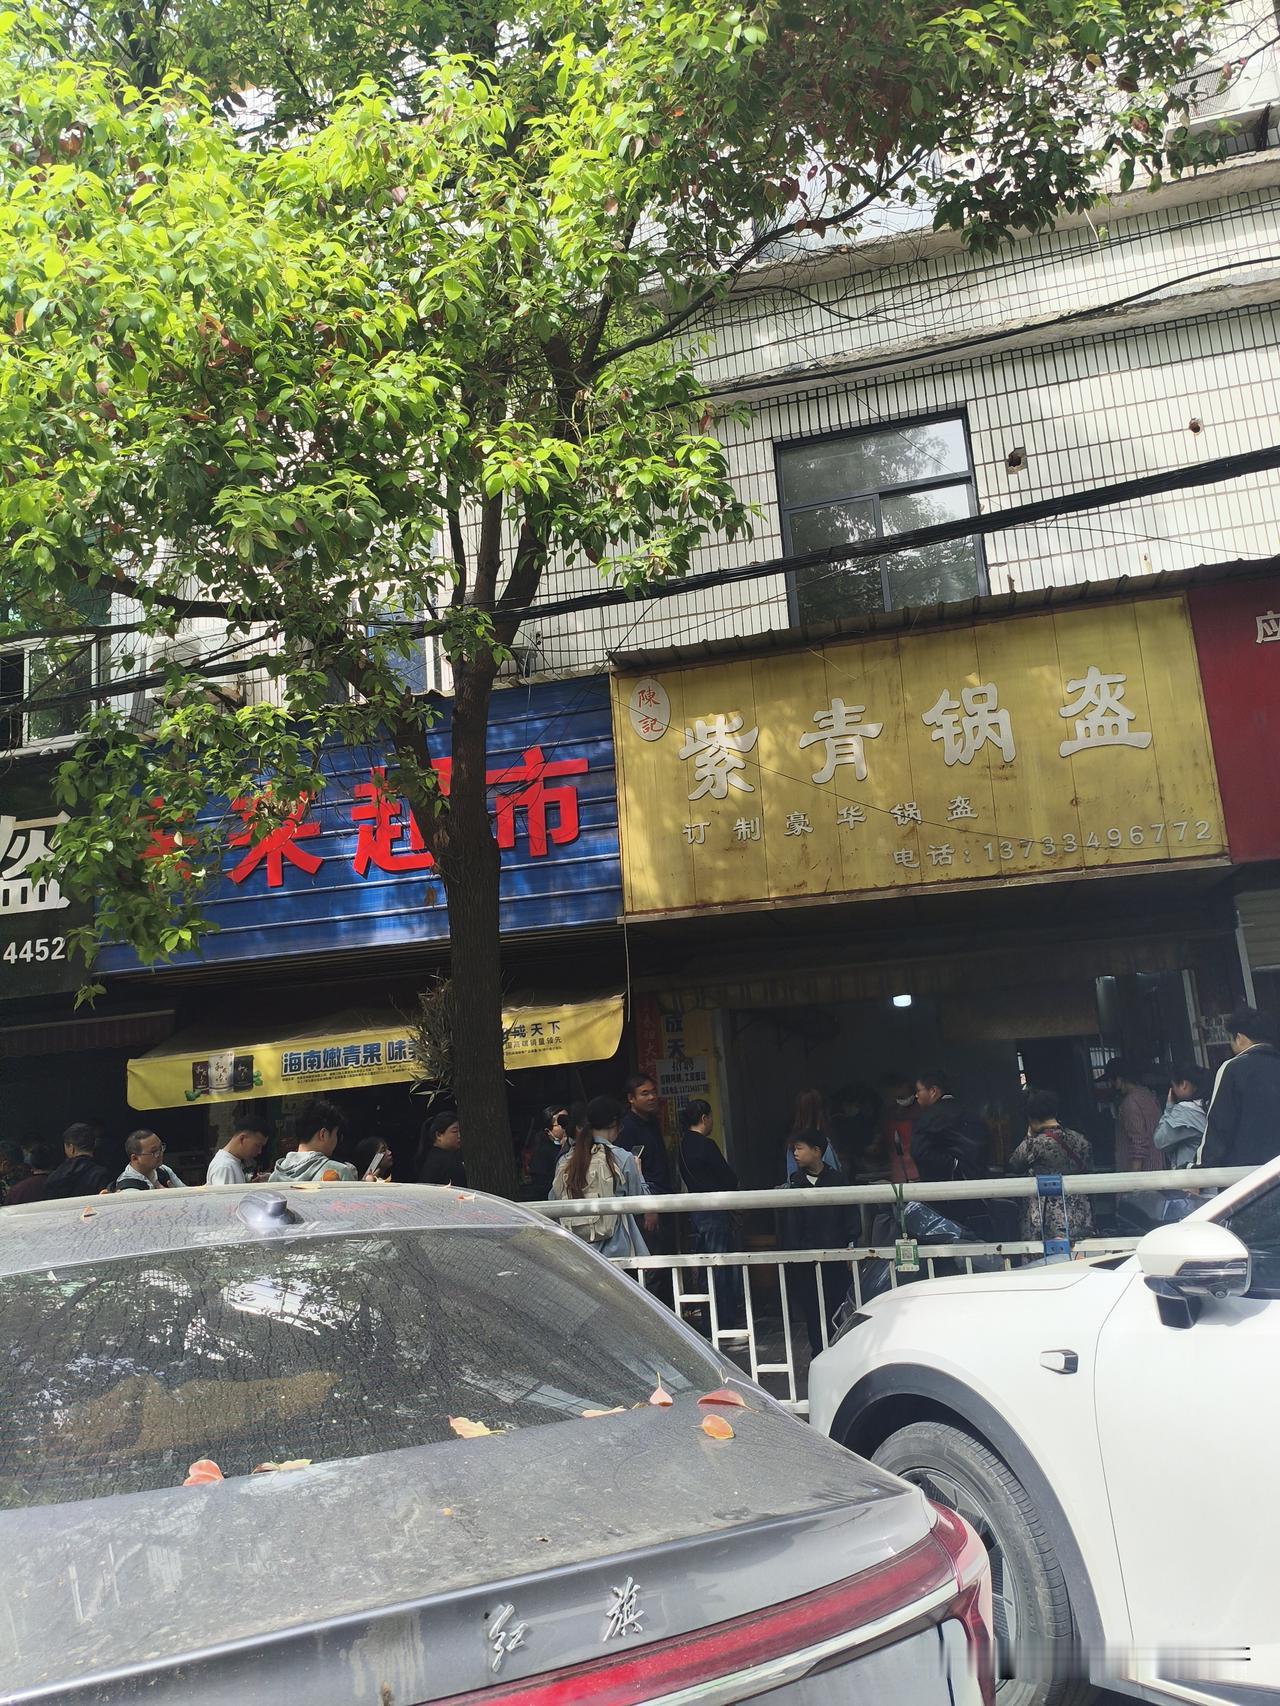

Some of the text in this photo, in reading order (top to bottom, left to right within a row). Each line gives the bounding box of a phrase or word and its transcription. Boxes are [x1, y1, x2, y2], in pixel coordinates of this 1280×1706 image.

[637, 686, 665, 734] 陳記
[678, 665, 1153, 801] 紫青锅盔
[681, 794, 980, 845] 订制豪华锅盔
[3, 936, 66, 964] 4452
